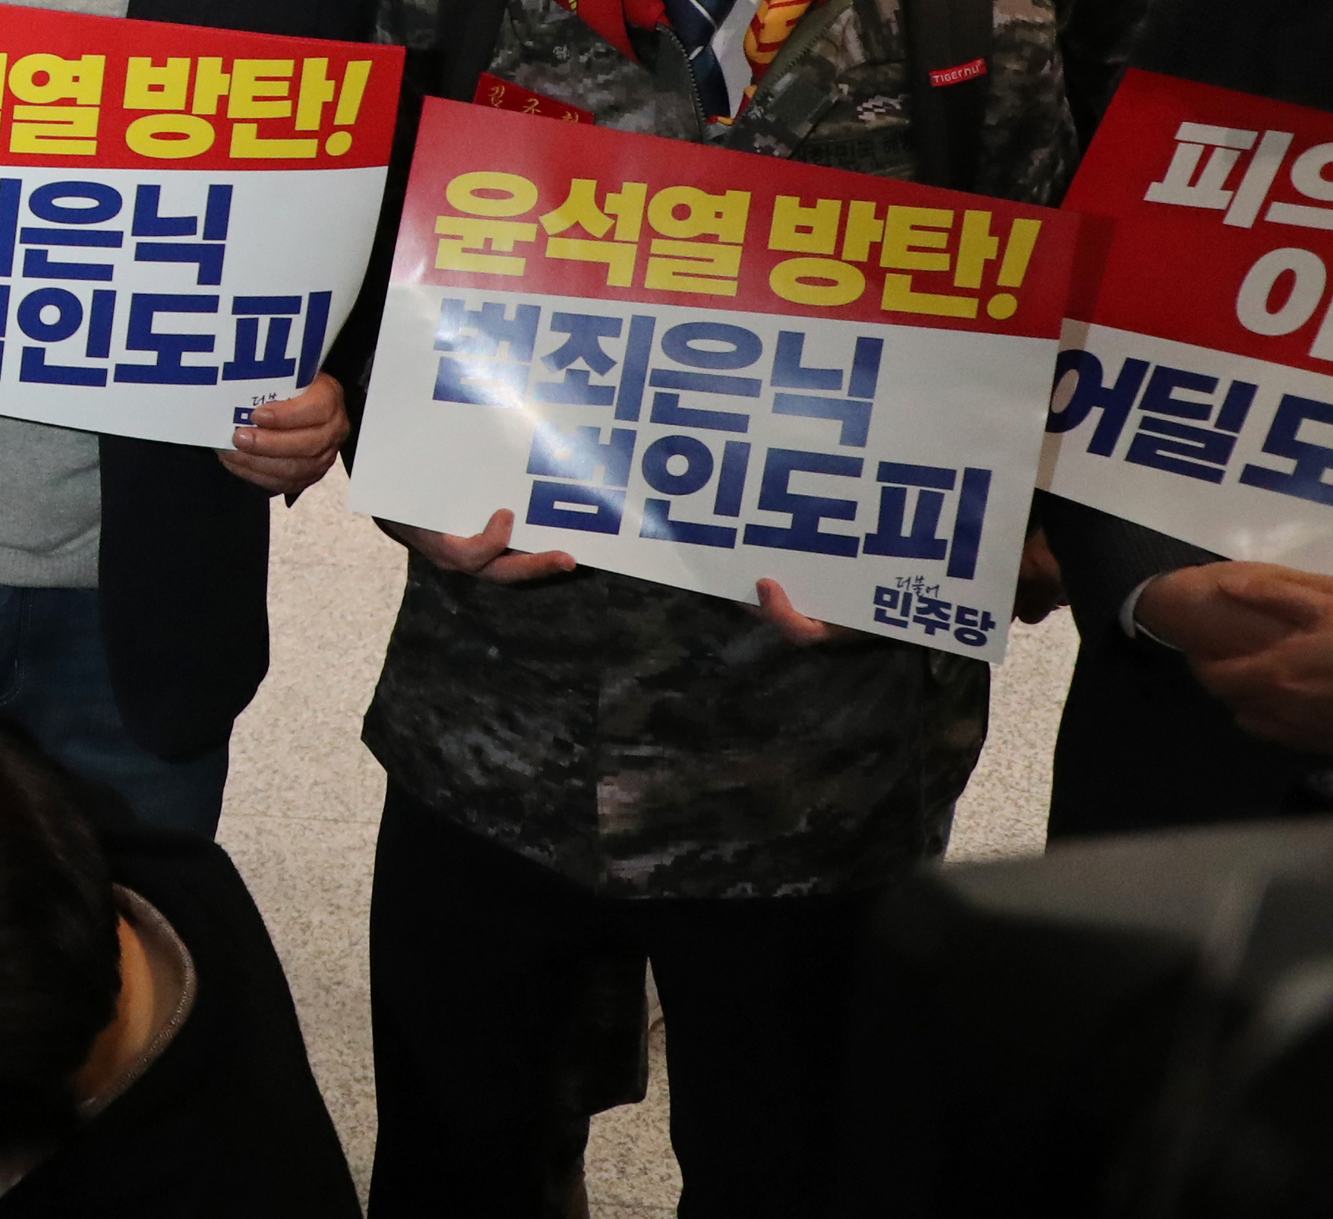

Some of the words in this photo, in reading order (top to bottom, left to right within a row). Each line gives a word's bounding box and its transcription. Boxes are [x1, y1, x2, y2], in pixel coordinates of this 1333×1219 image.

[123, 56, 373, 160] 방탄!
[434, 171, 747, 298] 윤석열
[768, 194, 1043, 321] 방탄!
[433, 298, 884, 447] 범죄은닉
[1045, 349, 1257, 484] 어딜
[526, 426, 992, 580] 범인도피
[873, 584, 997, 648] 민주당
